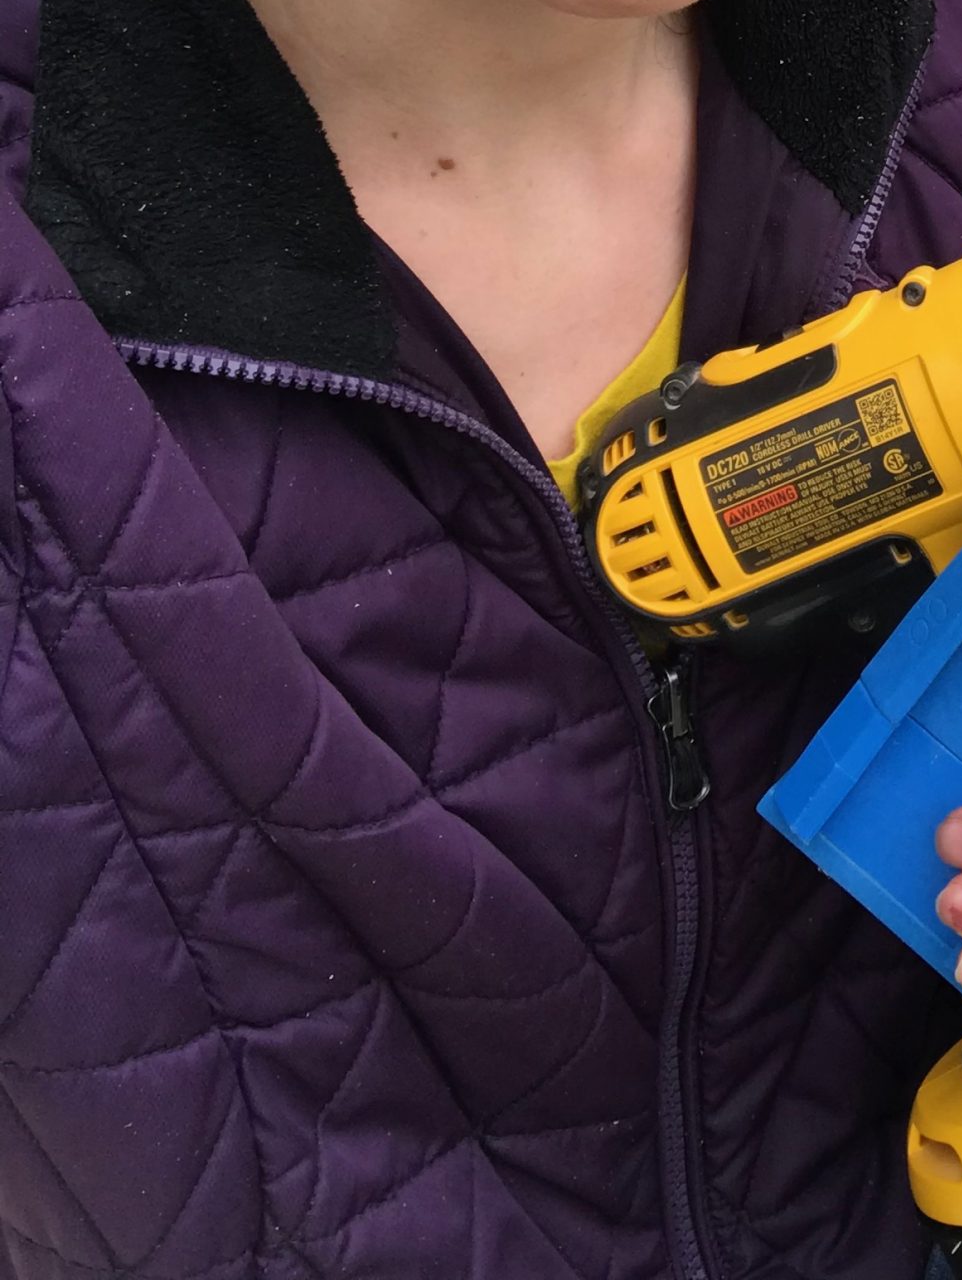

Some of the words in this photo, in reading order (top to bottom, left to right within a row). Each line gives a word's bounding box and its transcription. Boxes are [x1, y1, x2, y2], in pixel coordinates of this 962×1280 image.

[751, 439, 792, 462] CORDLESS
[791, 430, 814, 446] DRILL
[812, 417, 843, 436] DRIVER
[836, 430, 863, 450] ANCE
[815, 440, 841, 461] NOM
[705, 450, 751, 481] DC720
[909, 461, 924, 473] US
[713, 481, 732, 494] TYPE
[737, 487, 797, 521] WARNING
